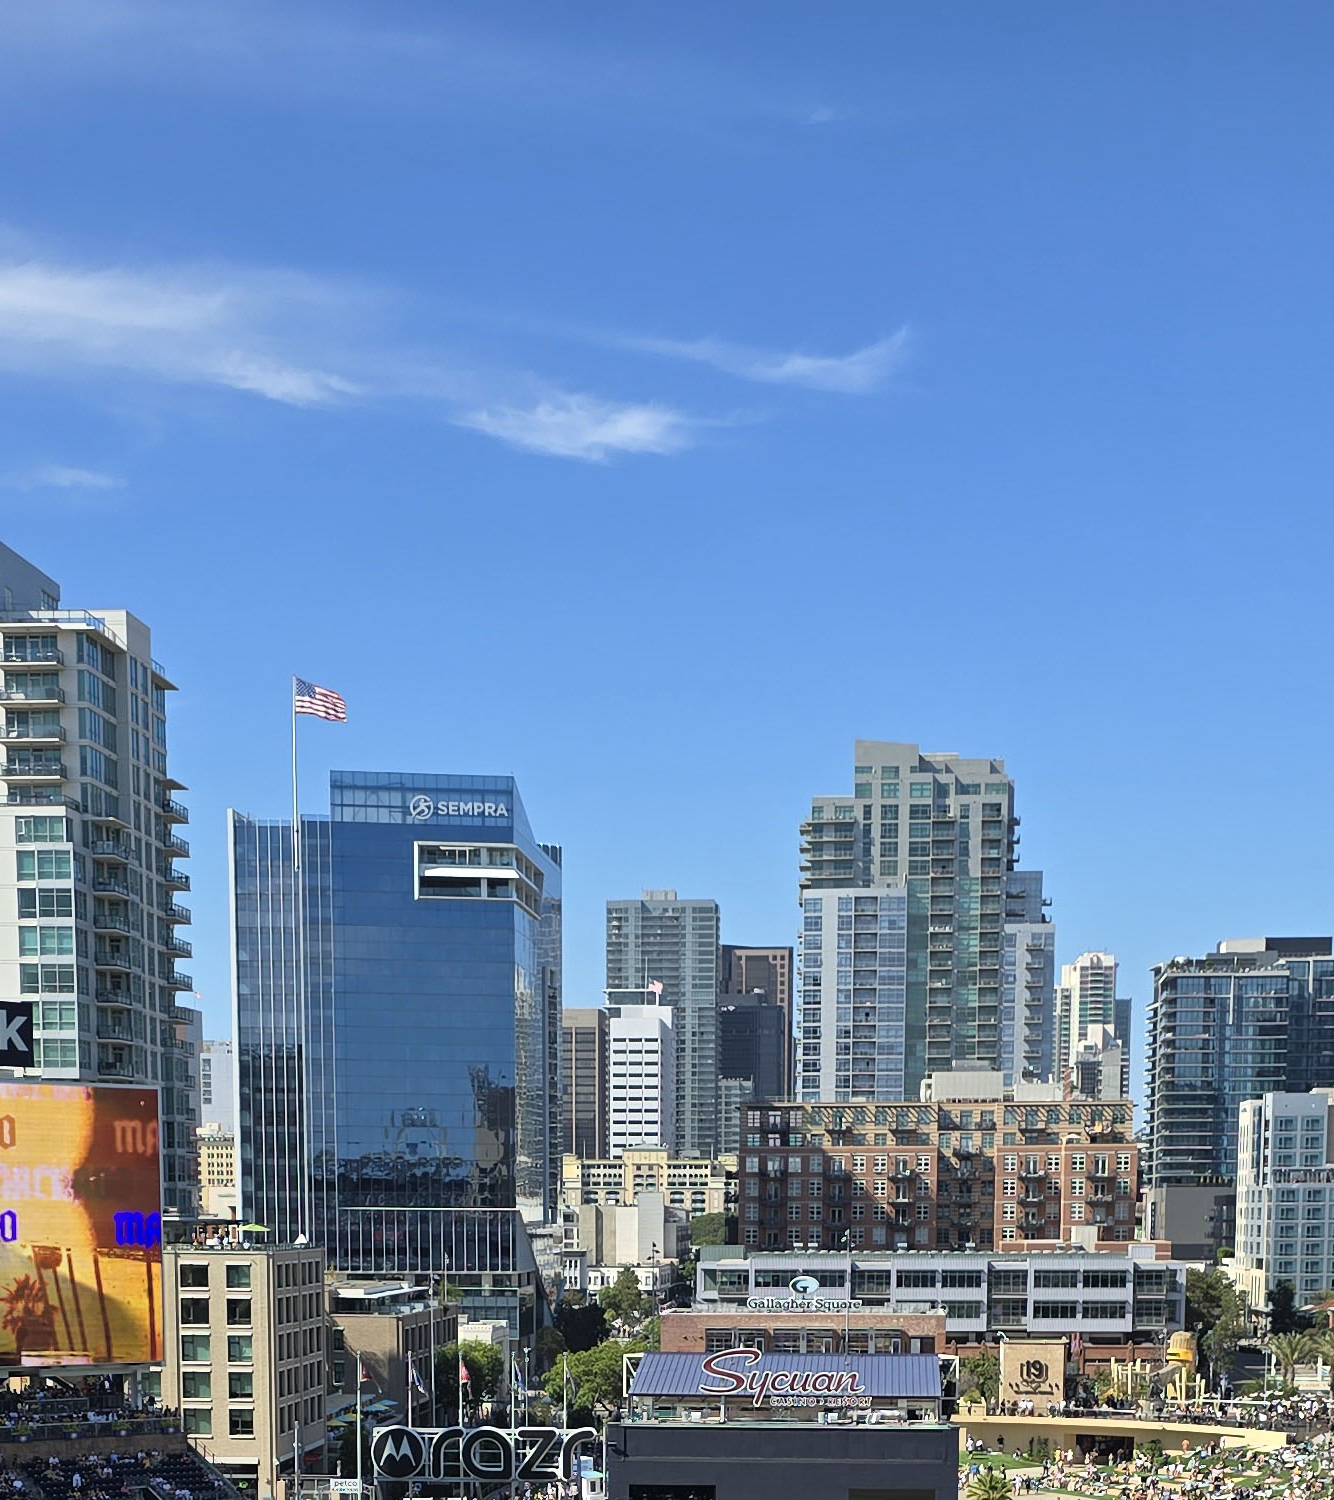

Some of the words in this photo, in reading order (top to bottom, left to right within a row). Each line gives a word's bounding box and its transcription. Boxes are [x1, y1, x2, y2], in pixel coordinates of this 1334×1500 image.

[437, 800, 509, 817] SEMPRA
[747, 1297, 813, 1313] Gallagher
[814, 1299, 862, 1313] Square
[699, 1348, 866, 1407] Sycuan
[770, 1396, 820, 1407] CASINO
[827, 1396, 873, 1408] RESORT
[430, 1426, 598, 1480] razr
